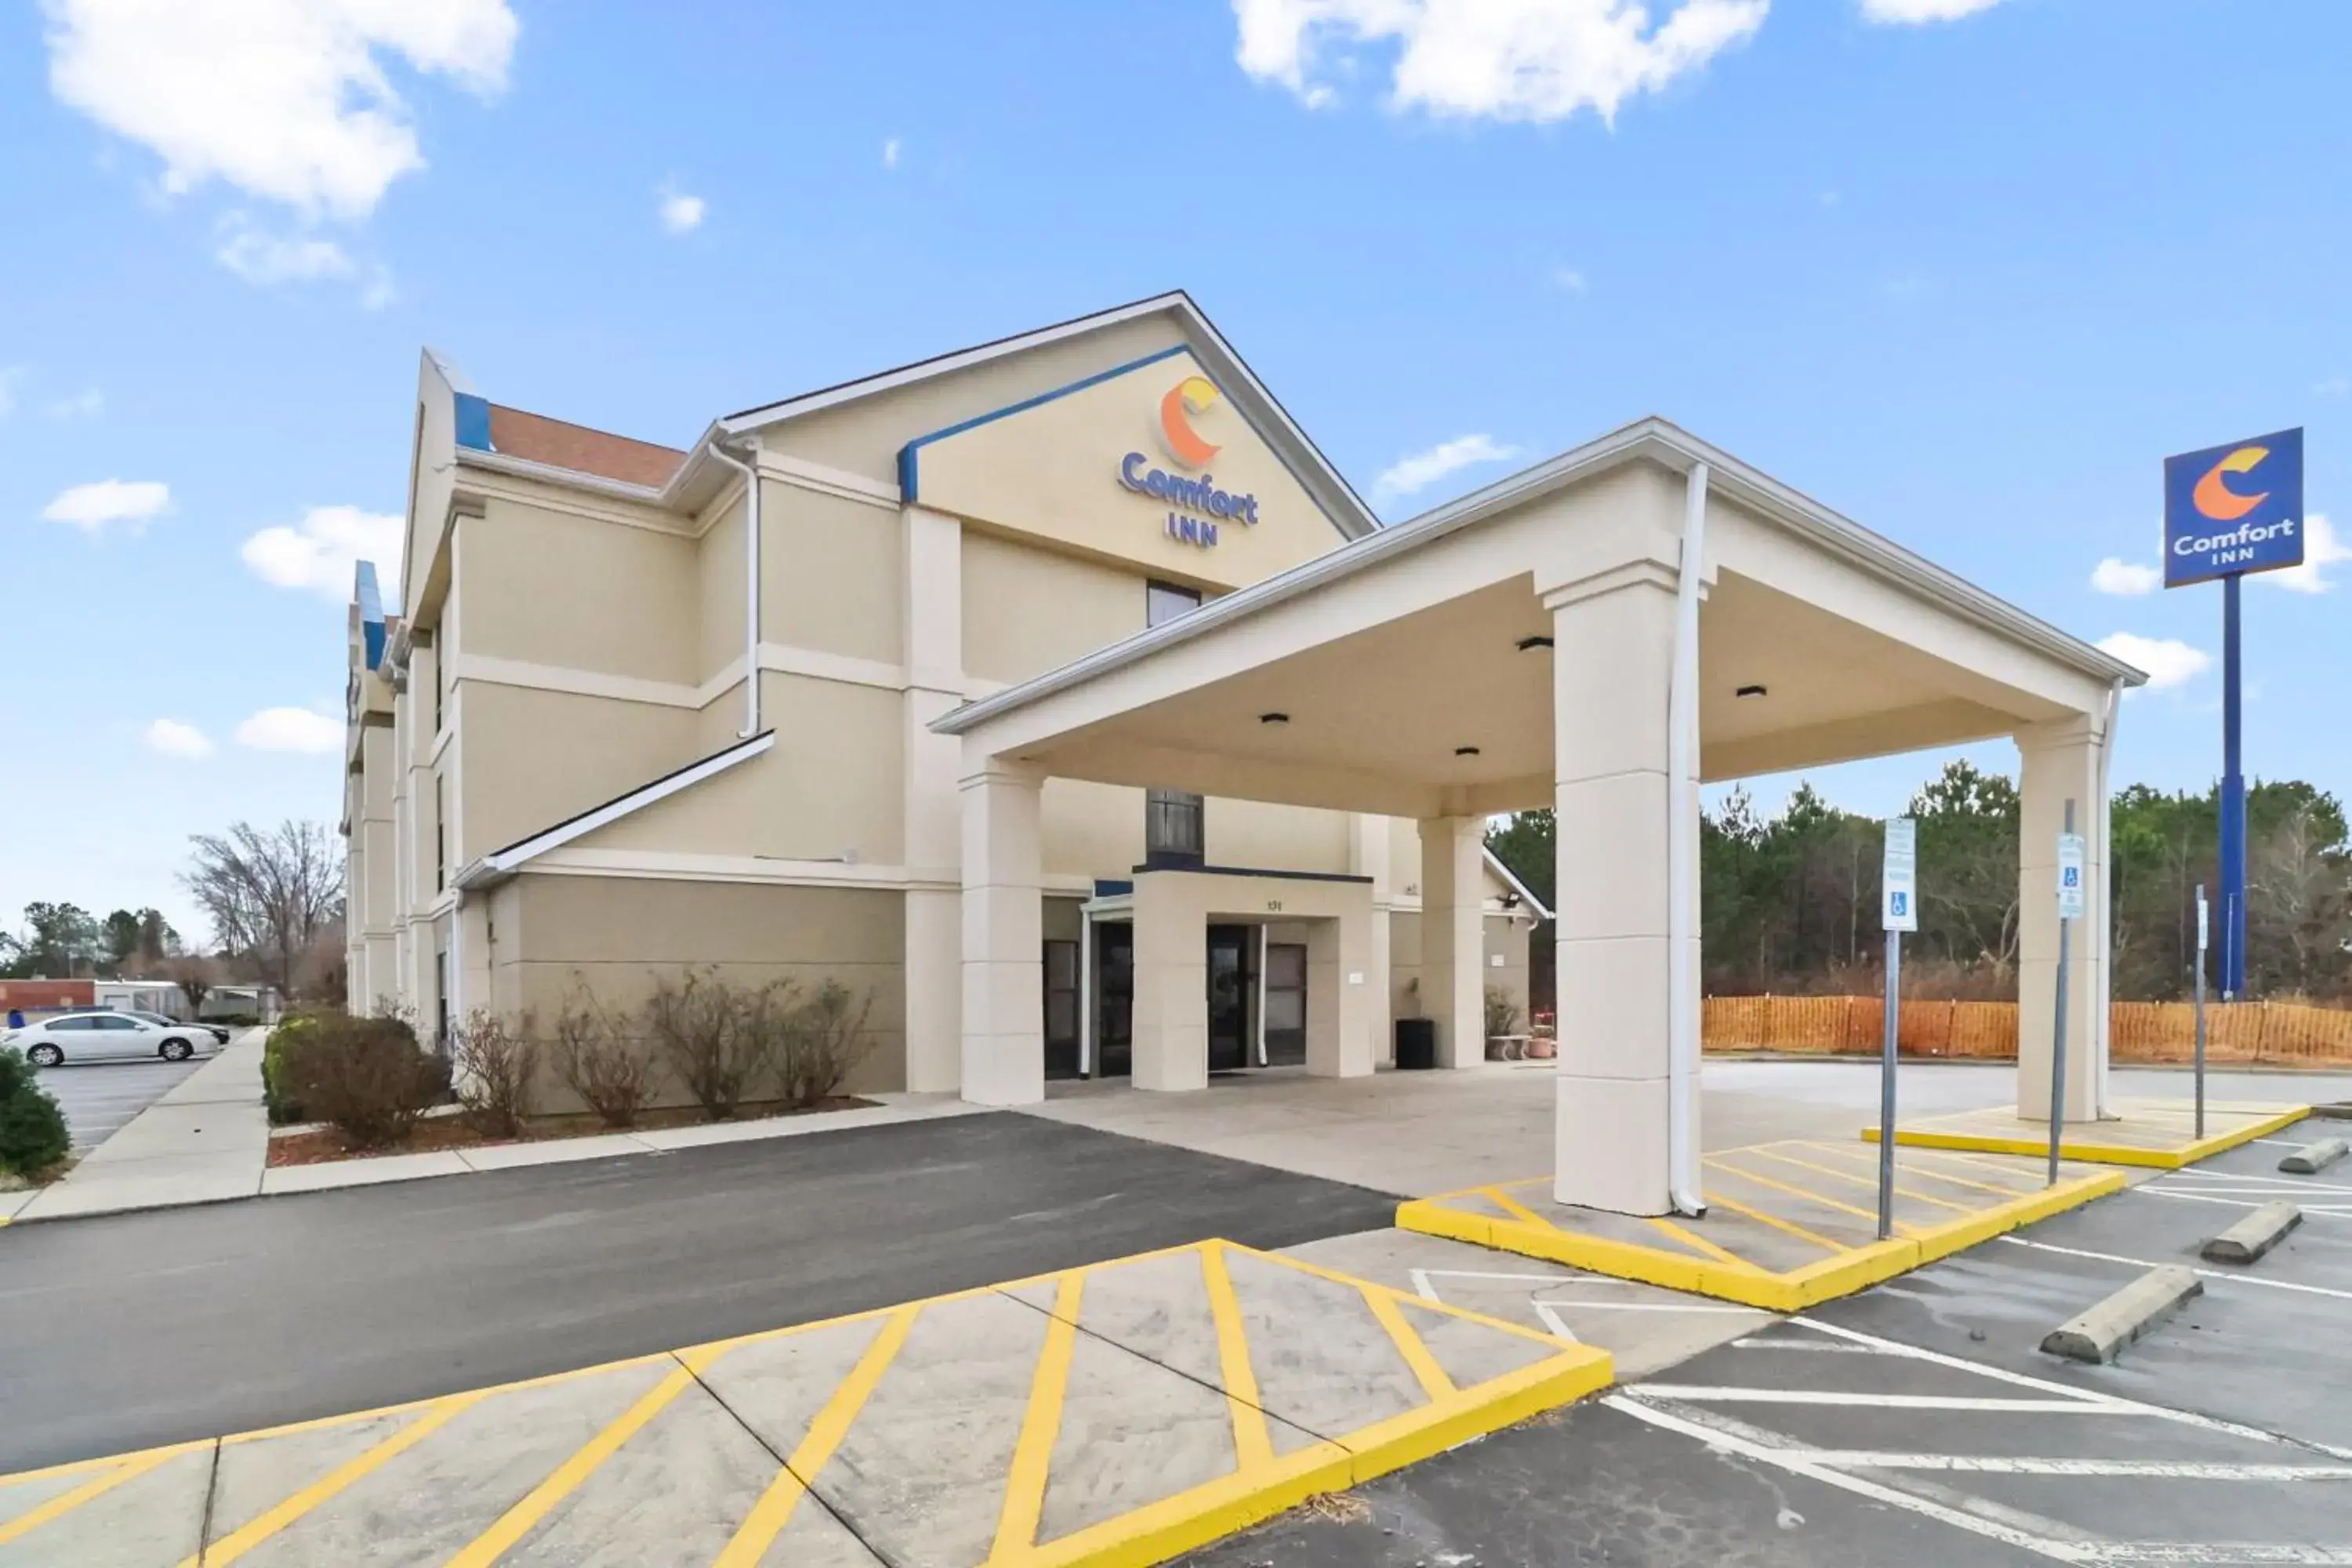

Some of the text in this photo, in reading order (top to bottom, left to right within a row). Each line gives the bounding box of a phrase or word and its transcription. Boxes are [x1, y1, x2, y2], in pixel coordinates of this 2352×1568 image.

[1120, 452, 1259, 525] Comfort
[1166, 512, 1218, 547] INN
[2173, 518, 2295, 555] Comfort
[2212, 547, 2254, 565] INN
